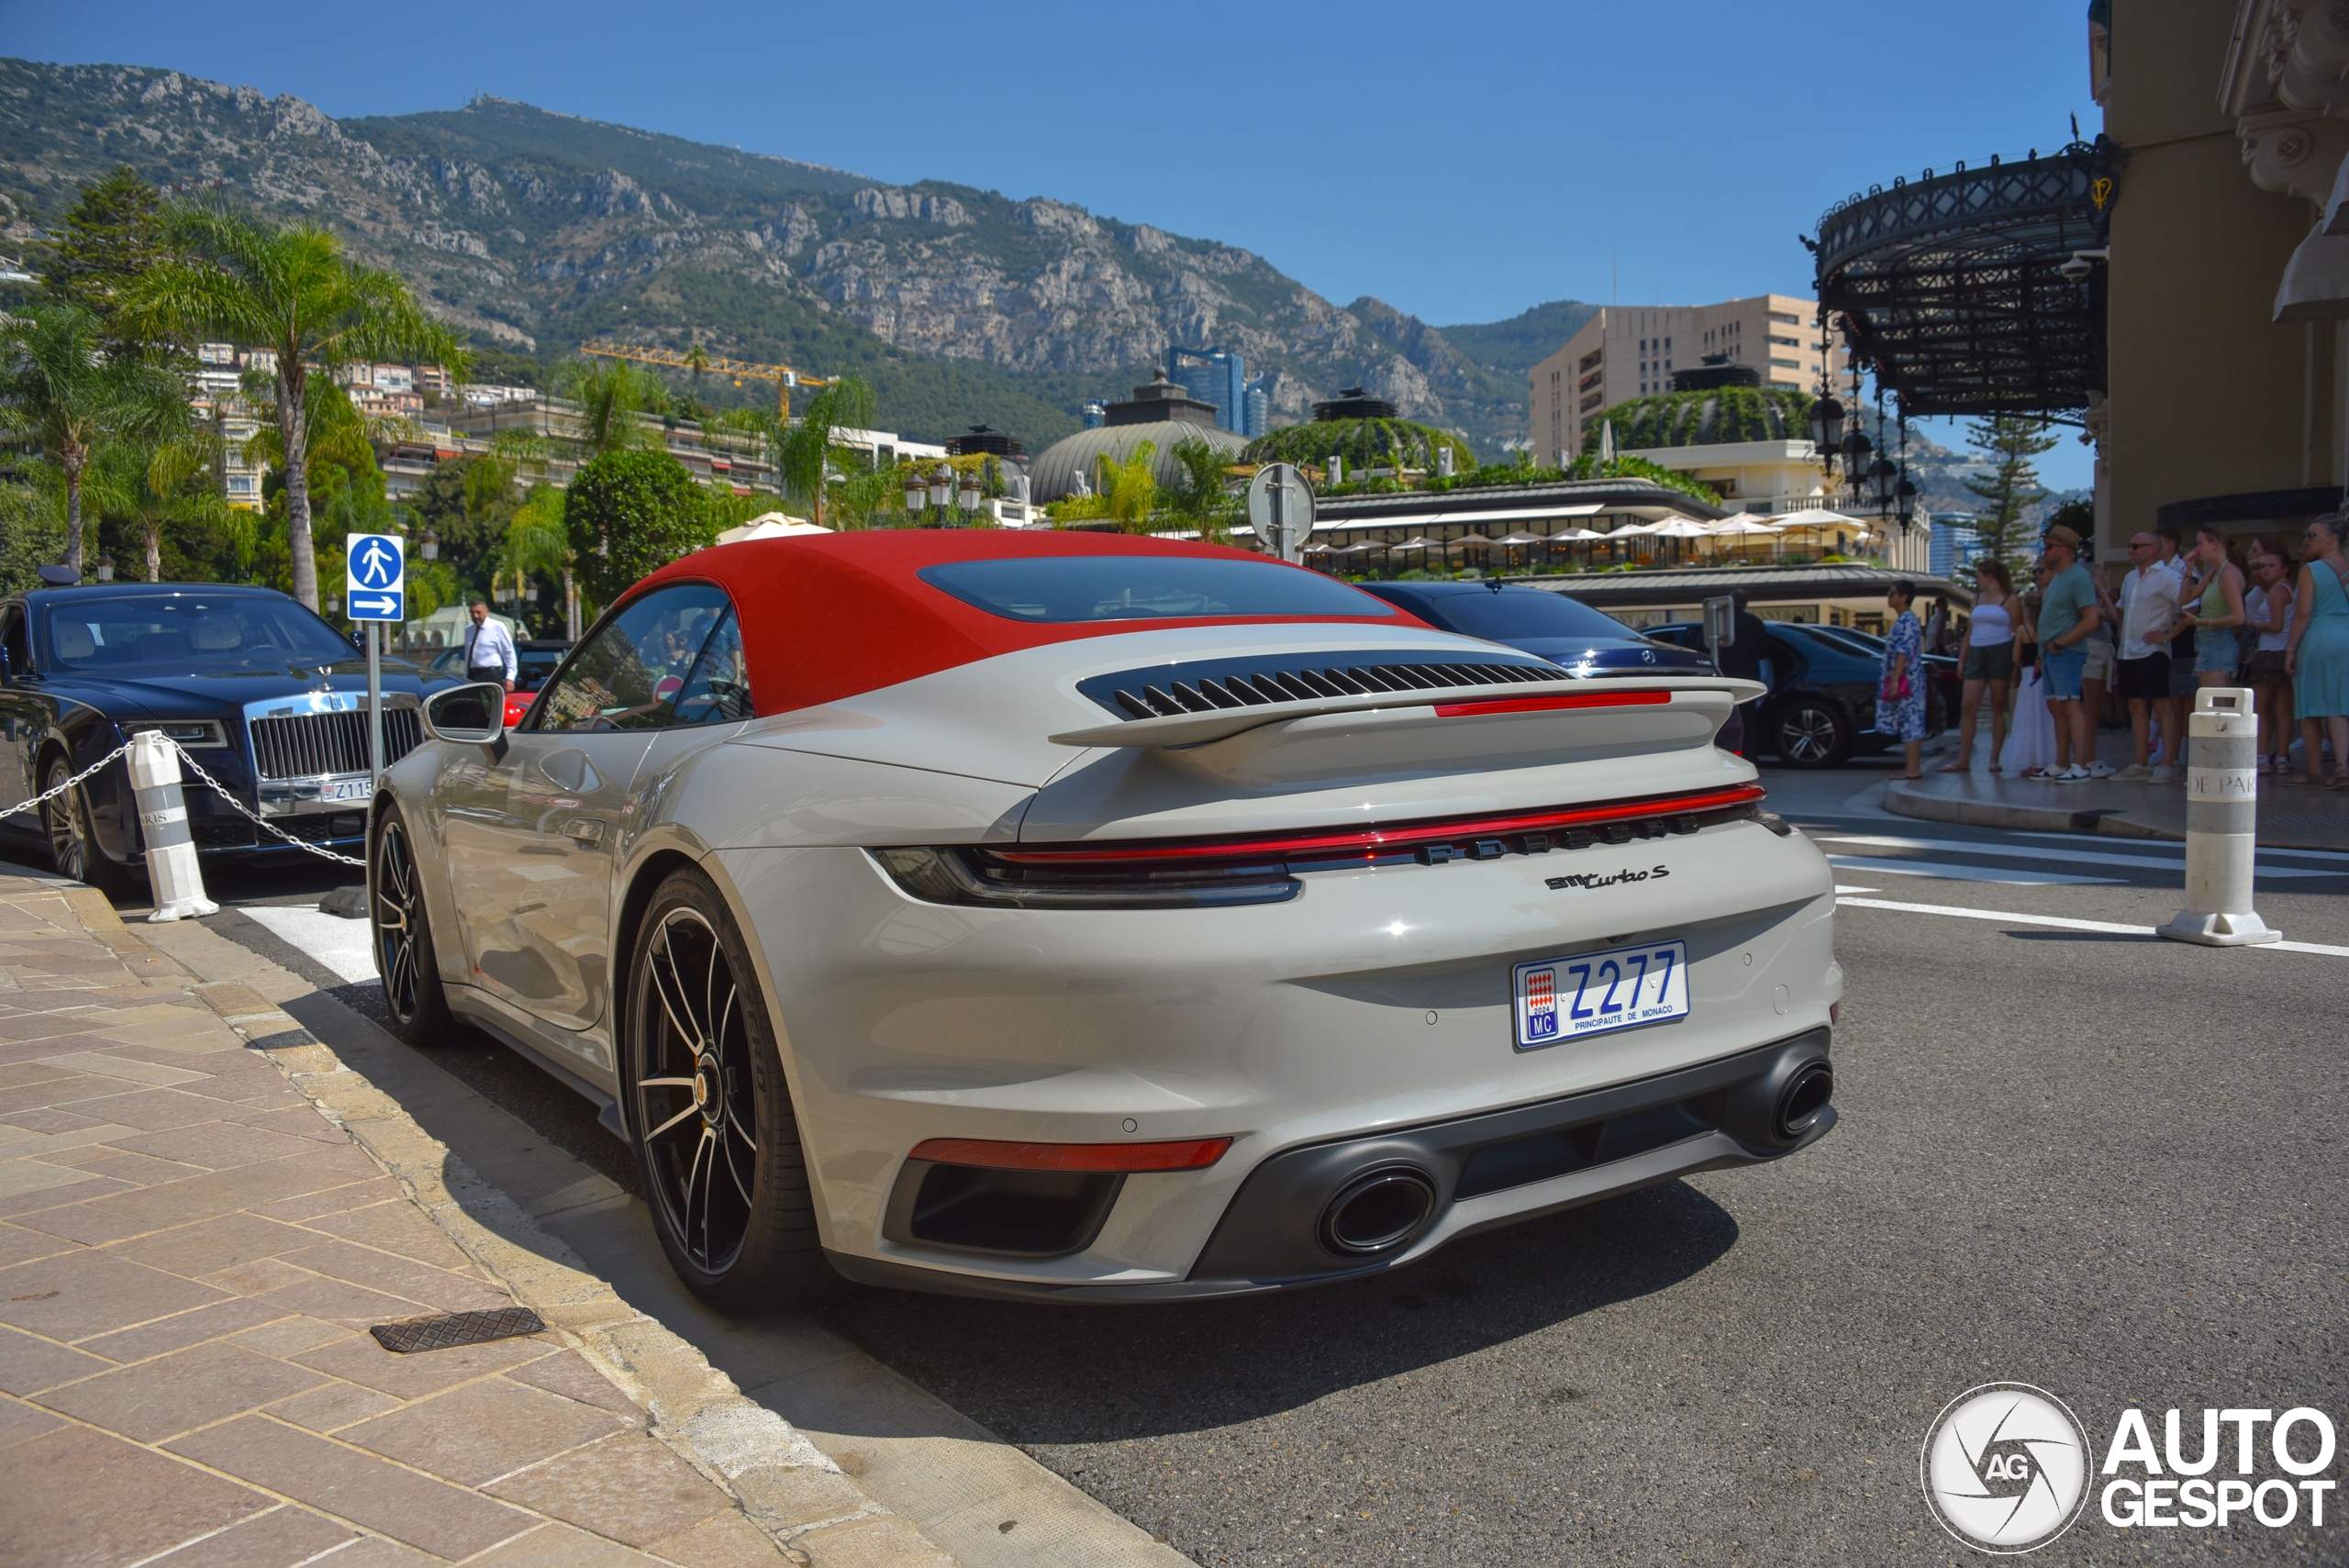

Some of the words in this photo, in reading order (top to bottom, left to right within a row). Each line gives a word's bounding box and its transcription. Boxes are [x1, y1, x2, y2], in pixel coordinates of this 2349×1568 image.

[2188, 776, 2210, 794] DE
[1651, 865, 1670, 879] S
[1569, 950, 1675, 1020] Z277
[1533, 1006, 1550, 1015] 2024
[1575, 1015, 1622, 1030] PRINCIPAUTE
[1628, 1012, 1637, 1020] DE
[1642, 1006, 1674, 1018] MONACO
[1533, 1015, 1552, 1035] MC
[740, 984, 767, 1094] ZERO
